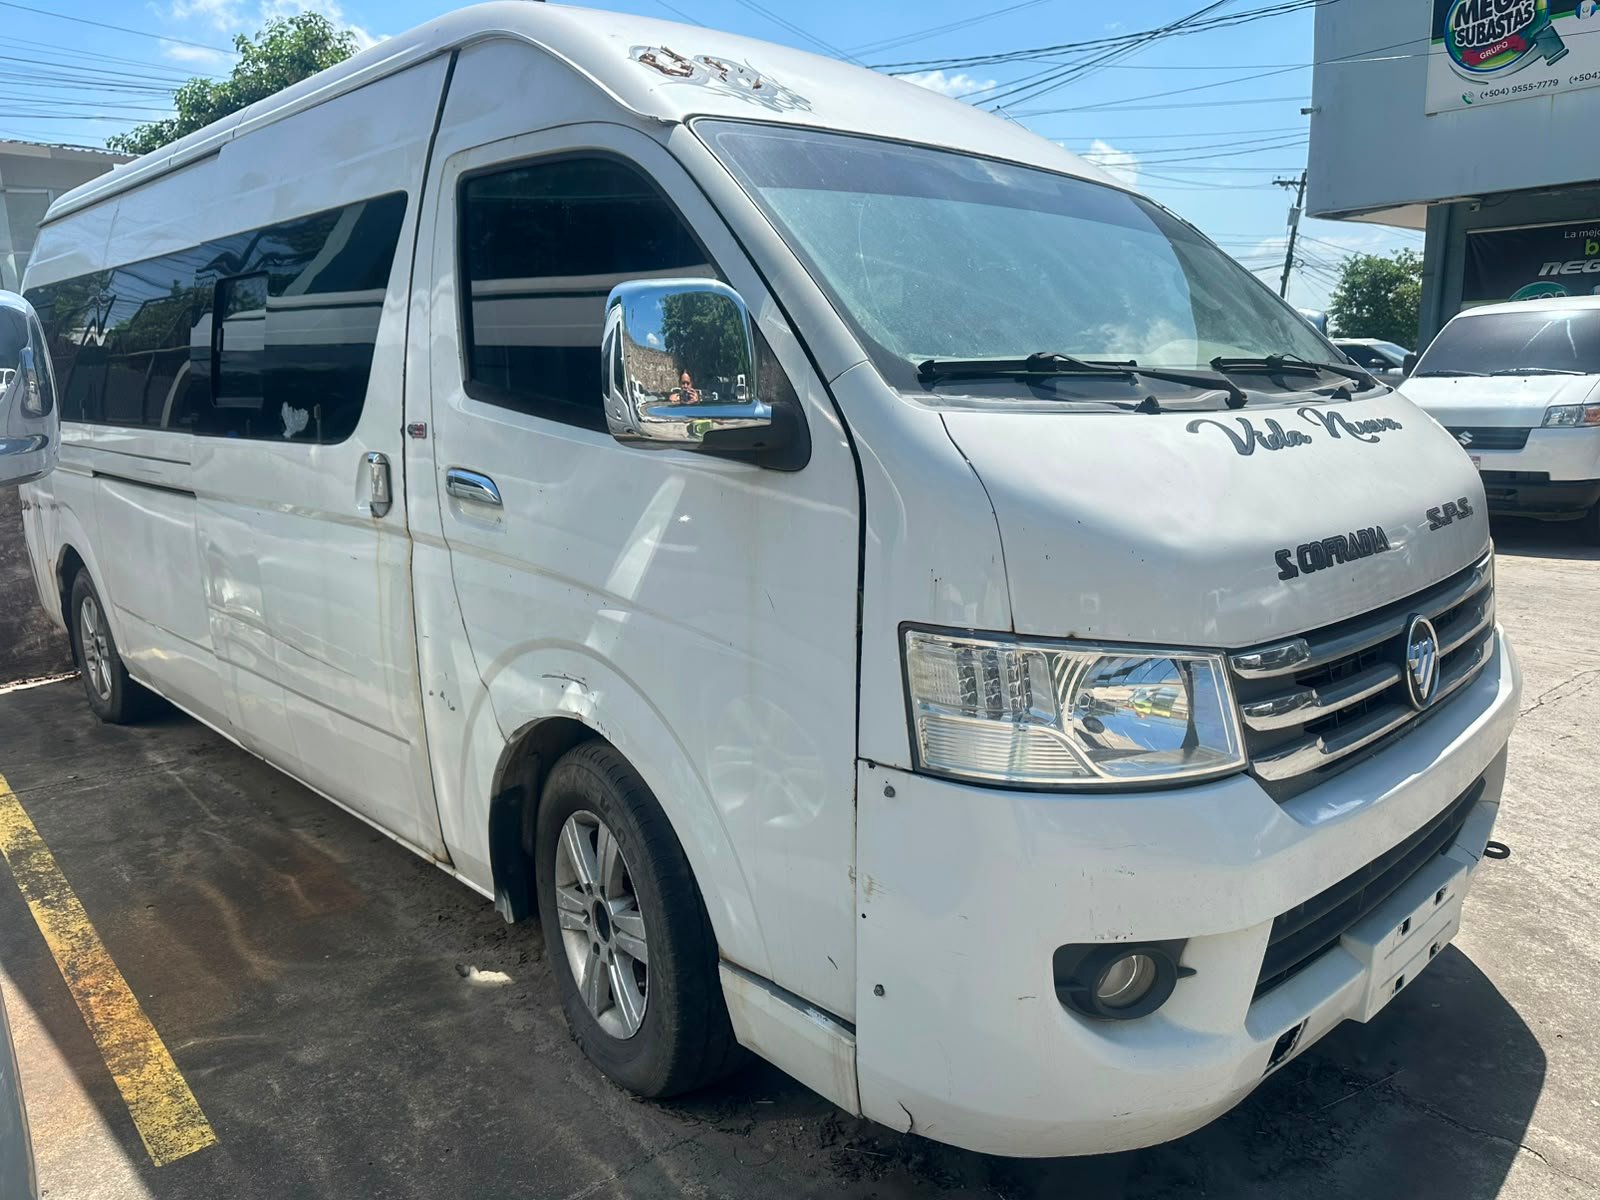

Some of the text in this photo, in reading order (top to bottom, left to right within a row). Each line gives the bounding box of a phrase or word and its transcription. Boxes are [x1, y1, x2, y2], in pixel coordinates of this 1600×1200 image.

[1454, 0, 1525, 29] MEG
[1456, 2, 1534, 46] SUBASTAS
[1479, 41, 1508, 59] GRUPO
[1480, 87, 1509, 100] (+504)
[1511, 79, 1559, 94] 9555-7779
[1564, 231, 1576, 239] La
[1186, 417, 1312, 456] Vida
